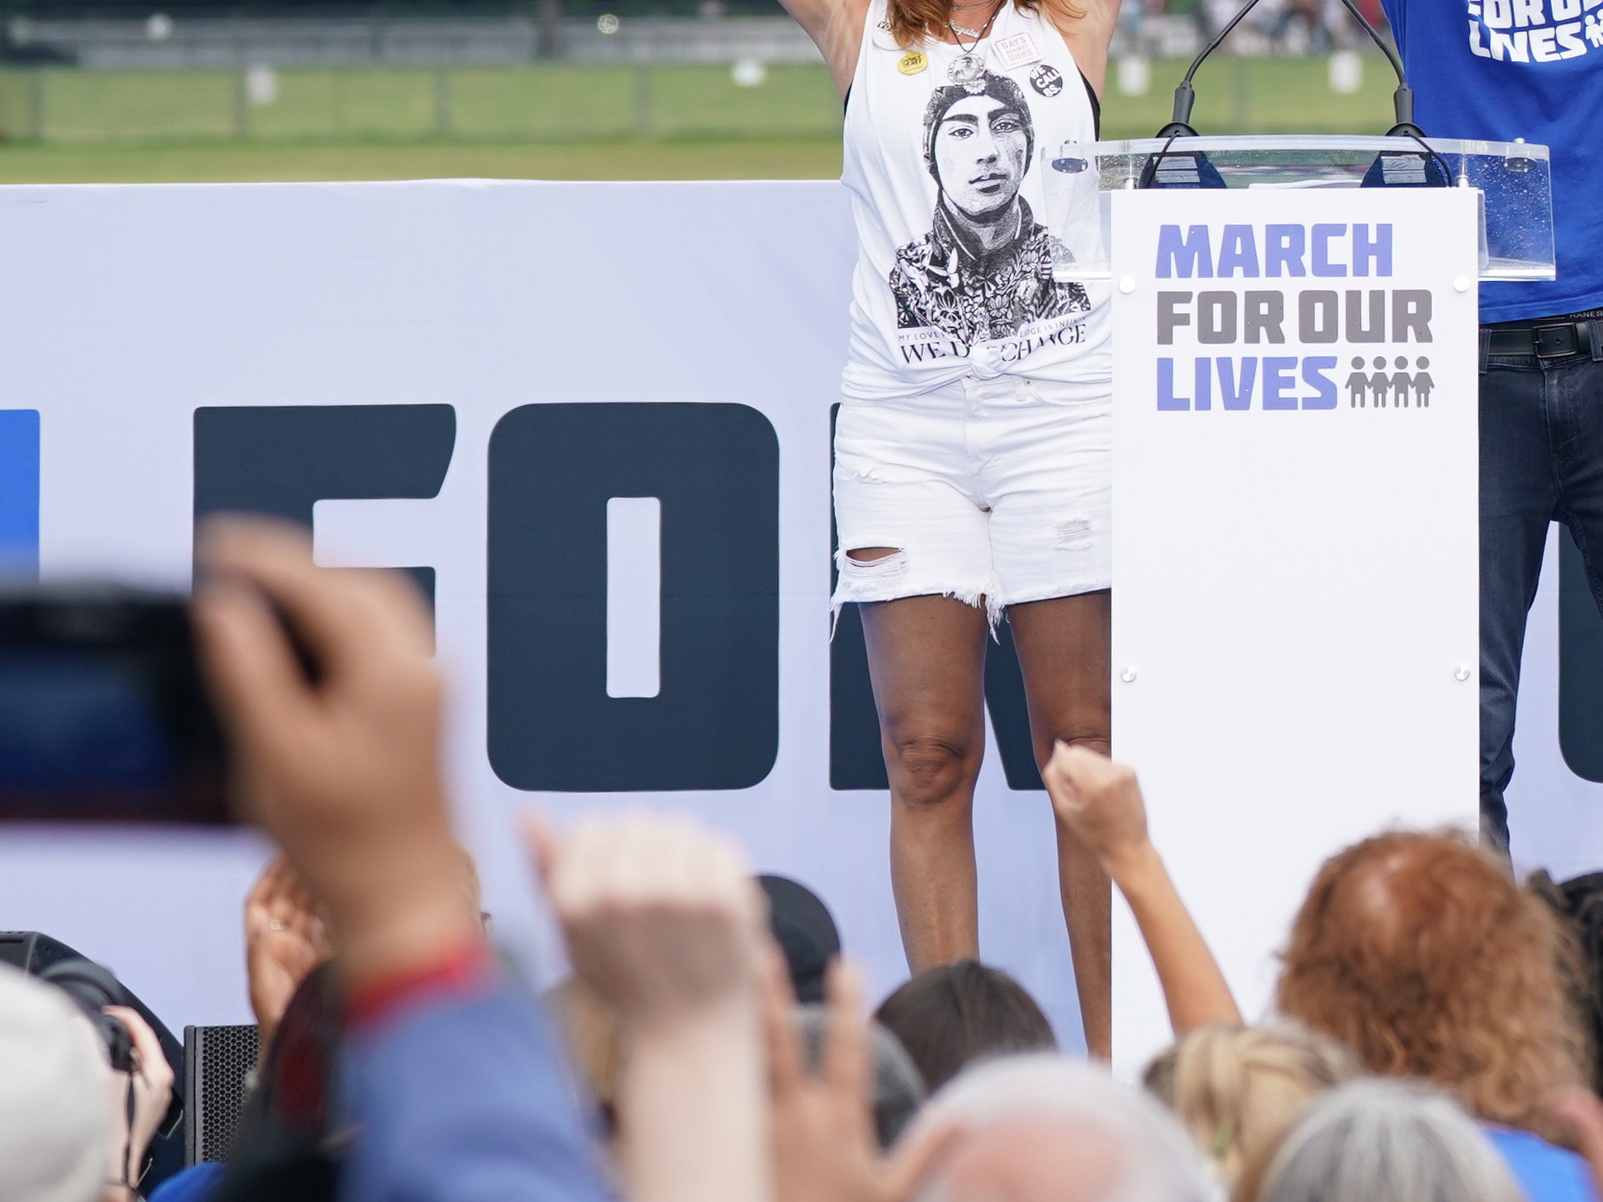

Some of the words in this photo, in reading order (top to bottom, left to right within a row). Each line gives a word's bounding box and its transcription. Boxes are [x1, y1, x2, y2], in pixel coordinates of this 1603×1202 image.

[1029, 64, 1046, 80] WE
[1036, 68, 1061, 89] CALL
[1155, 223, 1393, 278] MARCH
[1157, 290, 1285, 345] FOR
[1298, 289, 1433, 344] OUR
[914, 331, 940, 341] LOVE
[900, 341, 946, 364] WE
[1157, 356, 1338, 411] LIVES
